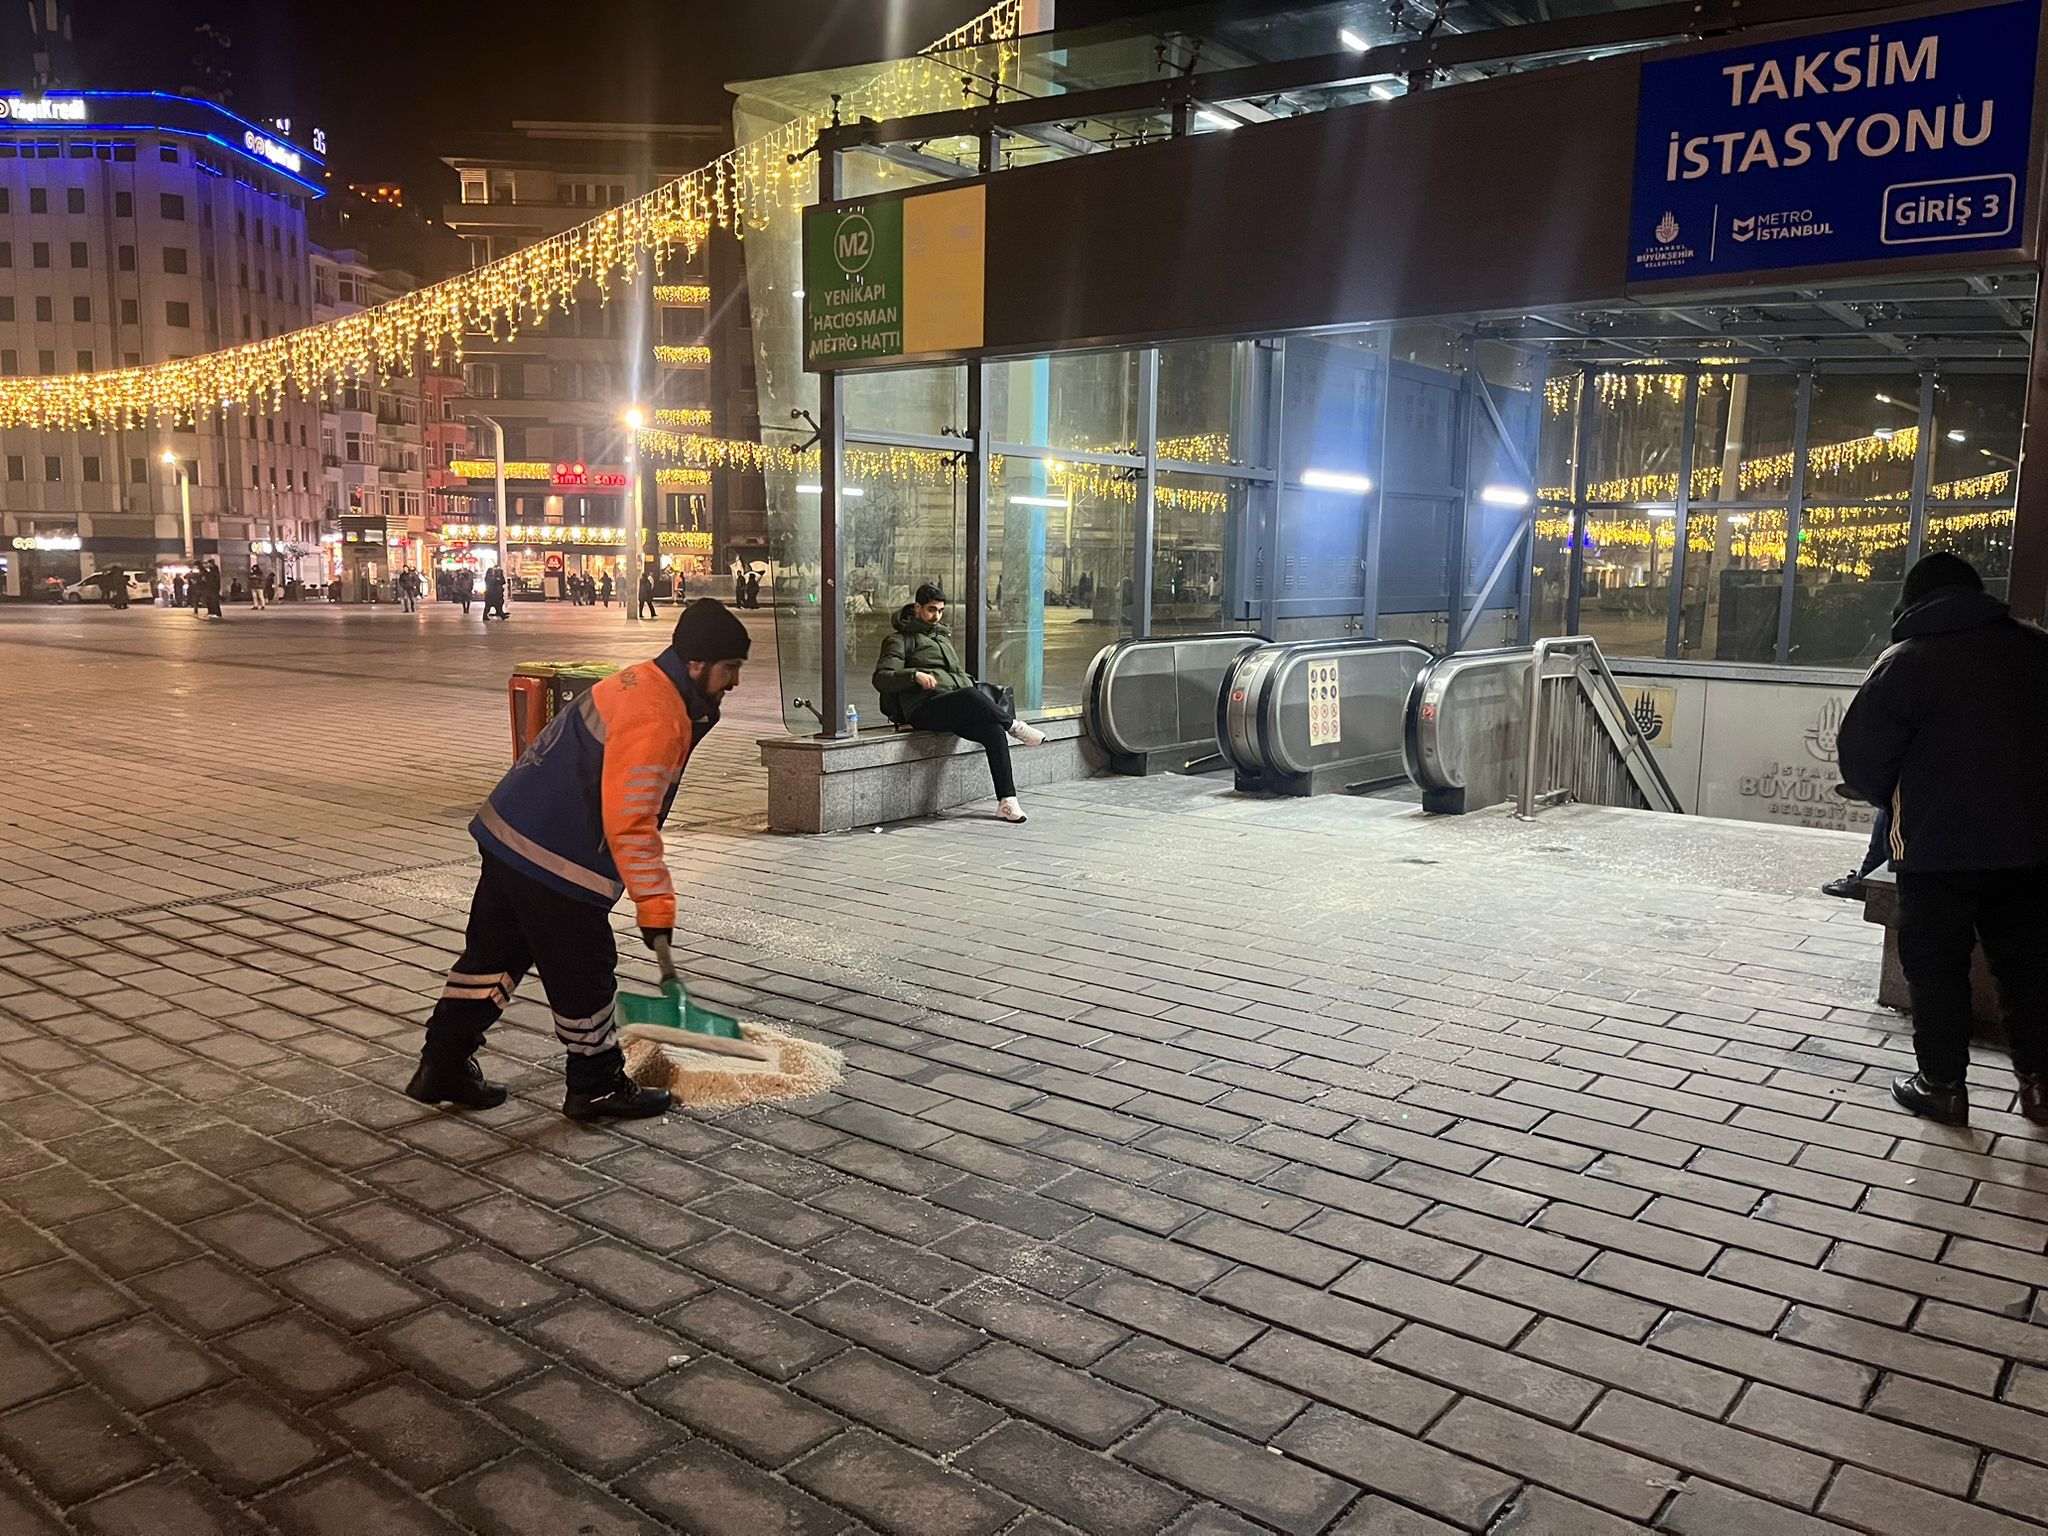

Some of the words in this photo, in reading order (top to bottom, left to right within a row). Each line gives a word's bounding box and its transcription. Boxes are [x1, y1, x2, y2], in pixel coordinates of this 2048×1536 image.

[1722, 33, 1939, 107] TAKSİM
[1666, 99, 1994, 182] İSTASYONU
[1757, 209, 1813, 226] METRO
[1894, 193, 1972, 226] GİRİŞ
[1981, 194, 2000, 218] 3
[839, 230, 869, 258] M2
[1756, 222, 1834, 242] İSTANBUL
[824, 283, 885, 307] YENİKAPI
[813, 306, 897, 332] HACIOSMAN
[811, 336, 857, 356] METRO
[861, 331, 900, 350] HATTI
[1768, 802, 1872, 824] BELEDİYES
